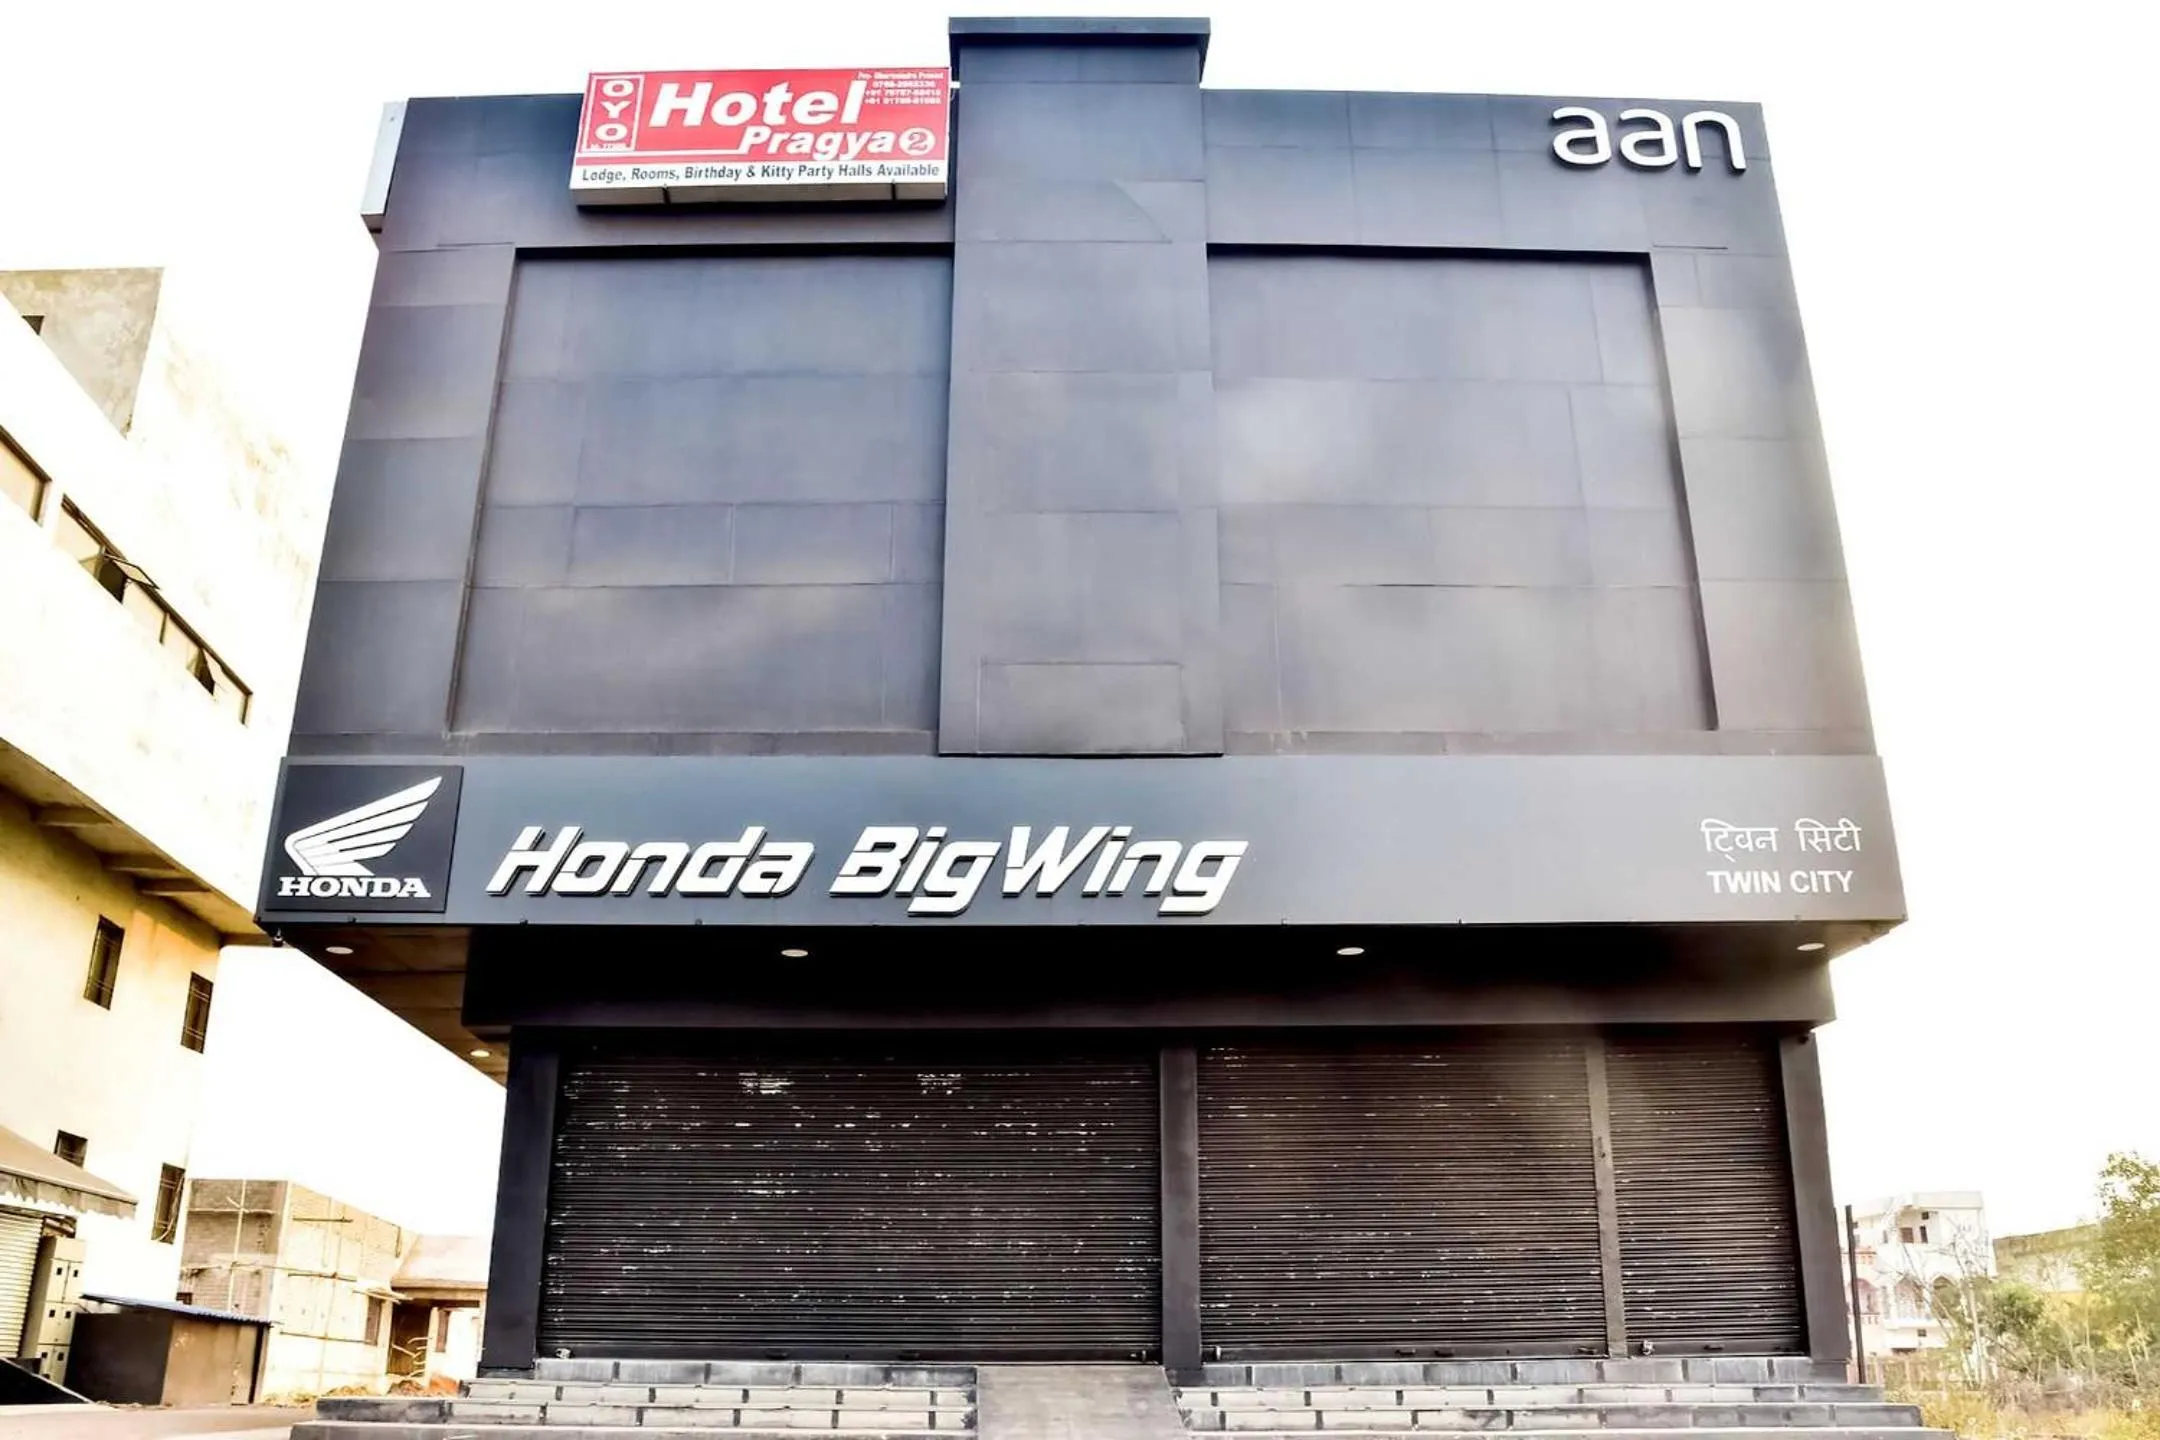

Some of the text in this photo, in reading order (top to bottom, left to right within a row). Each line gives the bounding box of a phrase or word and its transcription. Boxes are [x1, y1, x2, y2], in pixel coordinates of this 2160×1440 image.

[595, 80, 634, 142] OYO
[649, 81, 867, 127] Hotel
[738, 126, 899, 161] Pragya
[1552, 106, 1747, 172] aan
[582, 163, 940, 184] Lodge, Rooms, Birthday & Kitty Party Halls Available
[1794, 818, 1862, 853] सिटी
[484, 826, 815, 899] Honda
[278, 875, 431, 899] HONDA
[1706, 870, 1853, 894] TWIN CITY
